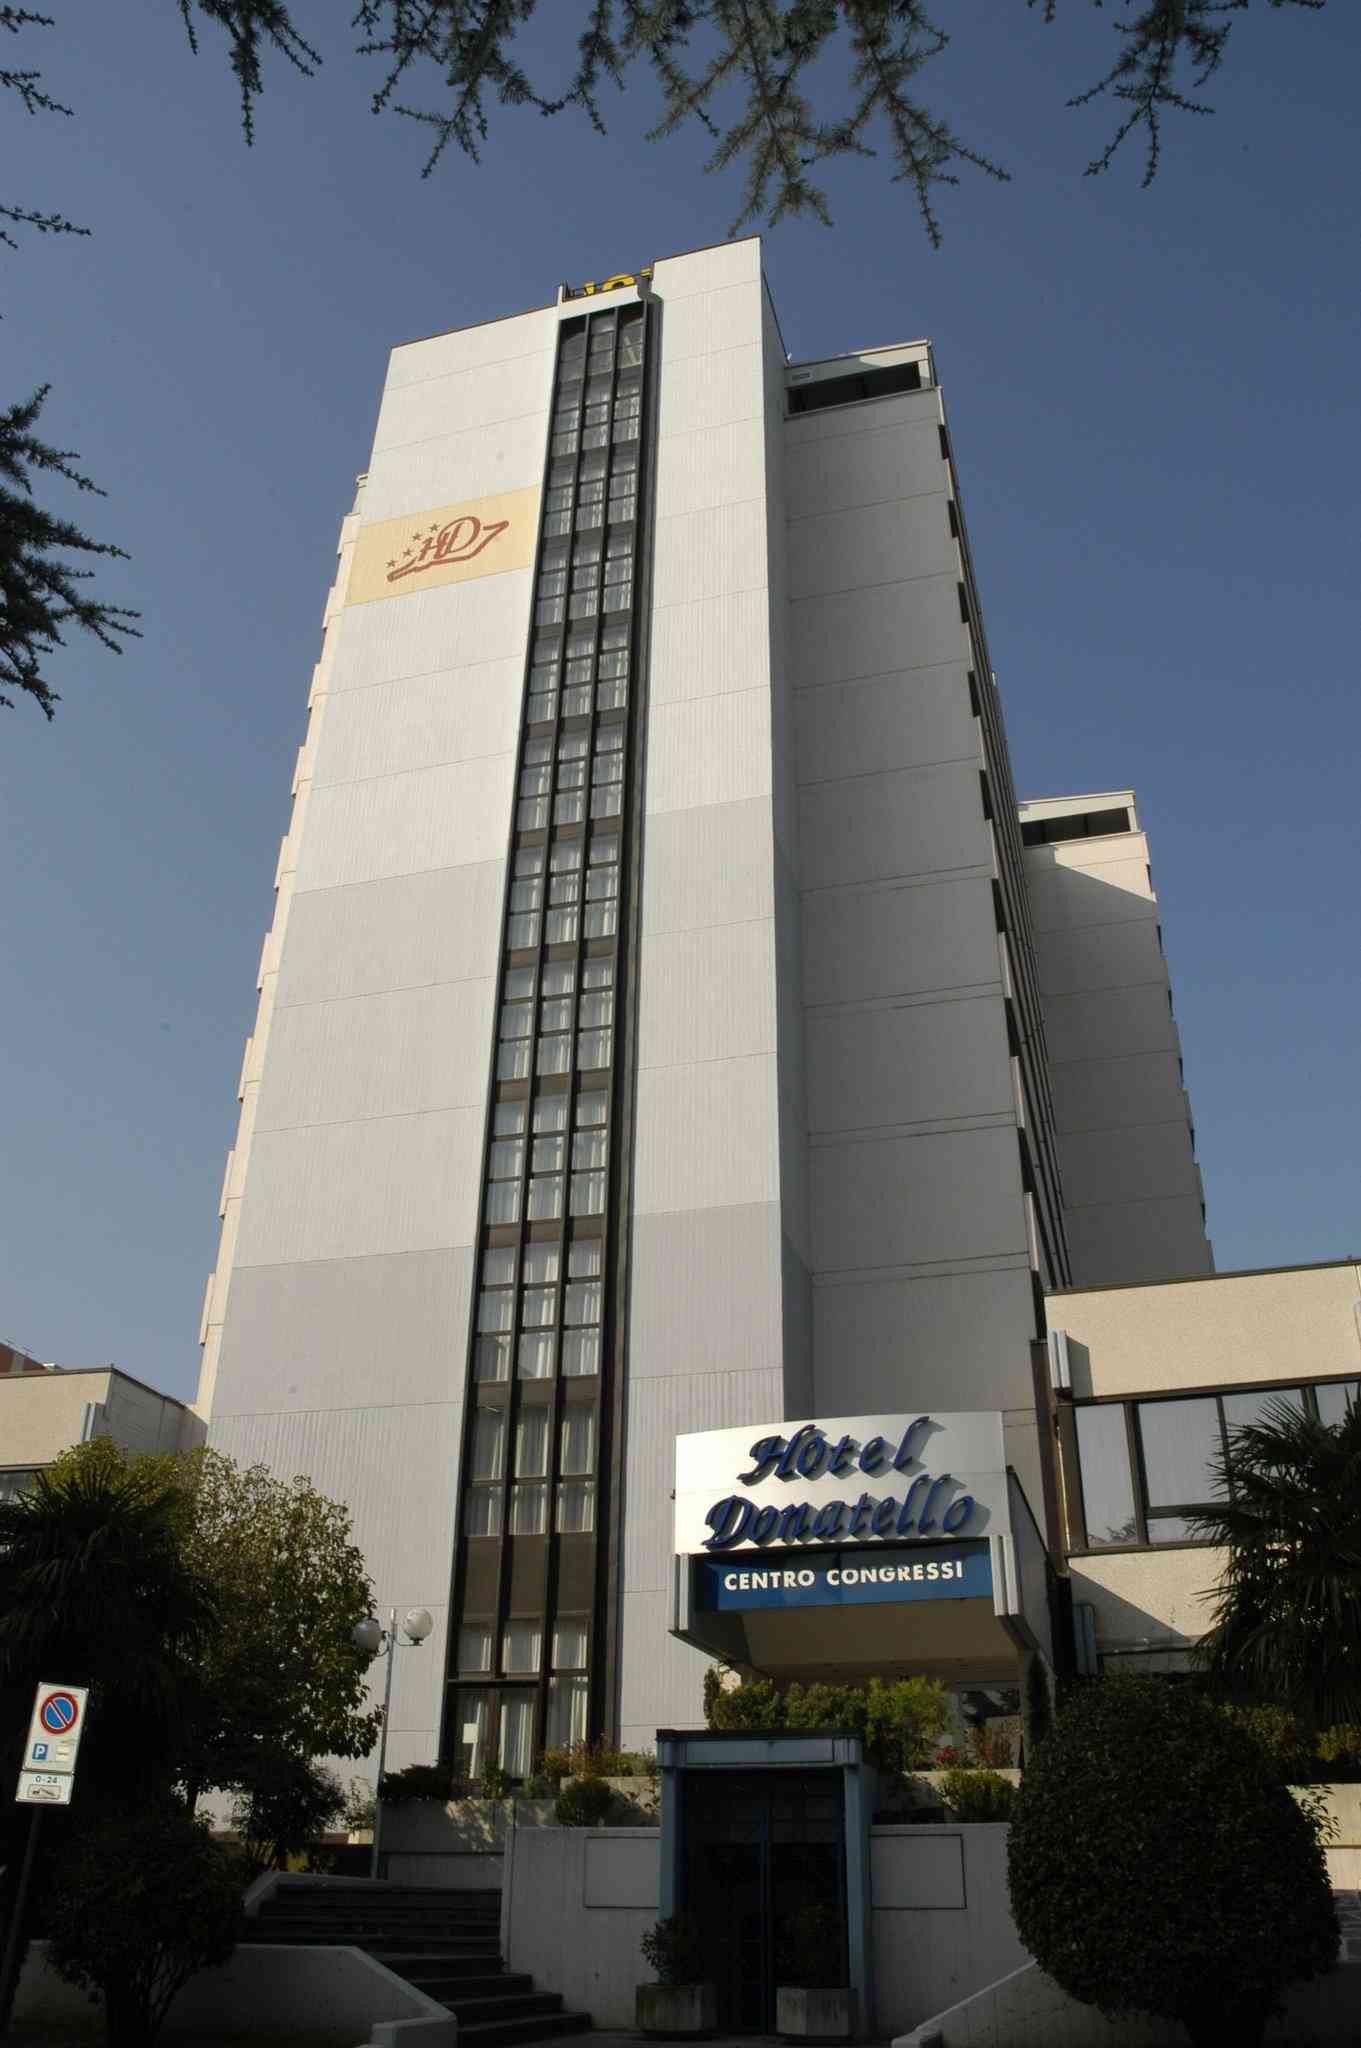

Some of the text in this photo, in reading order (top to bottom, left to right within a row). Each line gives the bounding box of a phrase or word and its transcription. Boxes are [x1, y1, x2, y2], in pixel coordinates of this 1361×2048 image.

[737, 1415, 932, 1487] Hotel
[701, 1473, 976, 1550] Donatello
[723, 1560, 964, 1592] CENTRO CONGRESSI
[34, 1744, 46, 1759] P
